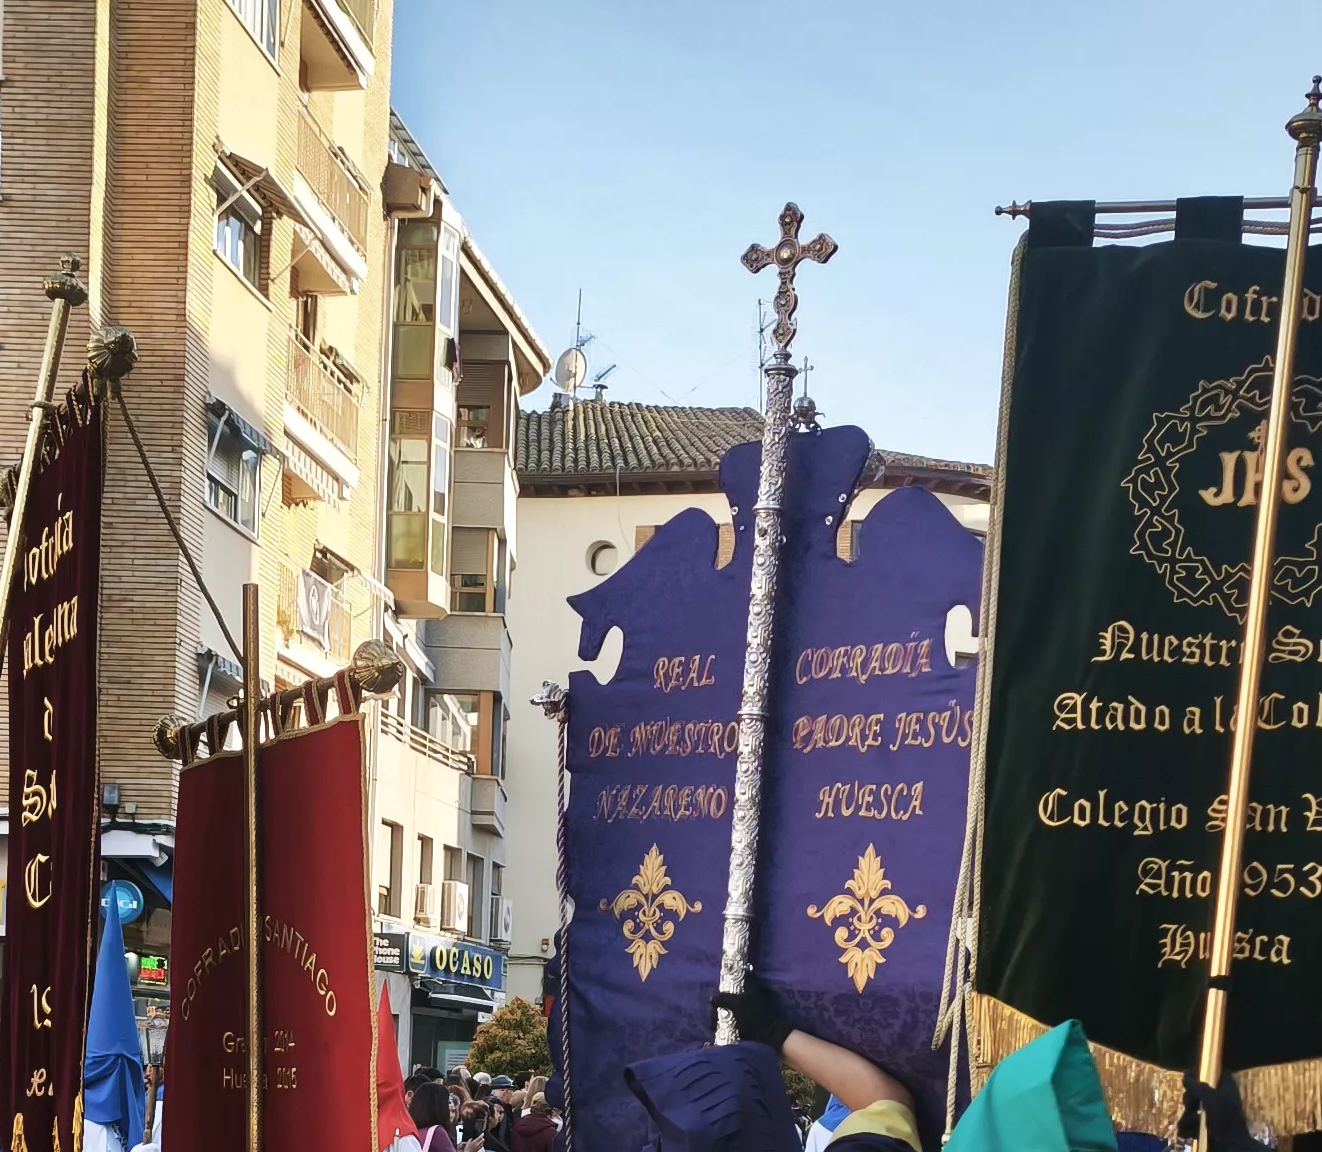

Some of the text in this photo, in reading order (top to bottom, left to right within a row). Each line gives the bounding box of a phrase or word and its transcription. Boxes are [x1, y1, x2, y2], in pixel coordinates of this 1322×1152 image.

[653, 654, 716, 691] REAL
[1052, 691, 1172, 732] Atado
[1182, 705, 1203, 736] a
[588, 725, 623, 759] DE
[627, 716, 740, 759] NUESTRO
[792, 713, 885, 754] PADRE
[592, 780, 925, 824] NAZARENO HUESCA
[1037, 786, 1189, 837] Colegio
[1204, 794, 1291, 833] San
[1135, 857, 1212, 899] Año
[180, 915, 337, 1021] COFRADI SANTIAGO
[373, 946, 401, 956] hone
[434, 944, 494, 980] OCASO
[1157, 923, 1293, 969] Husca
